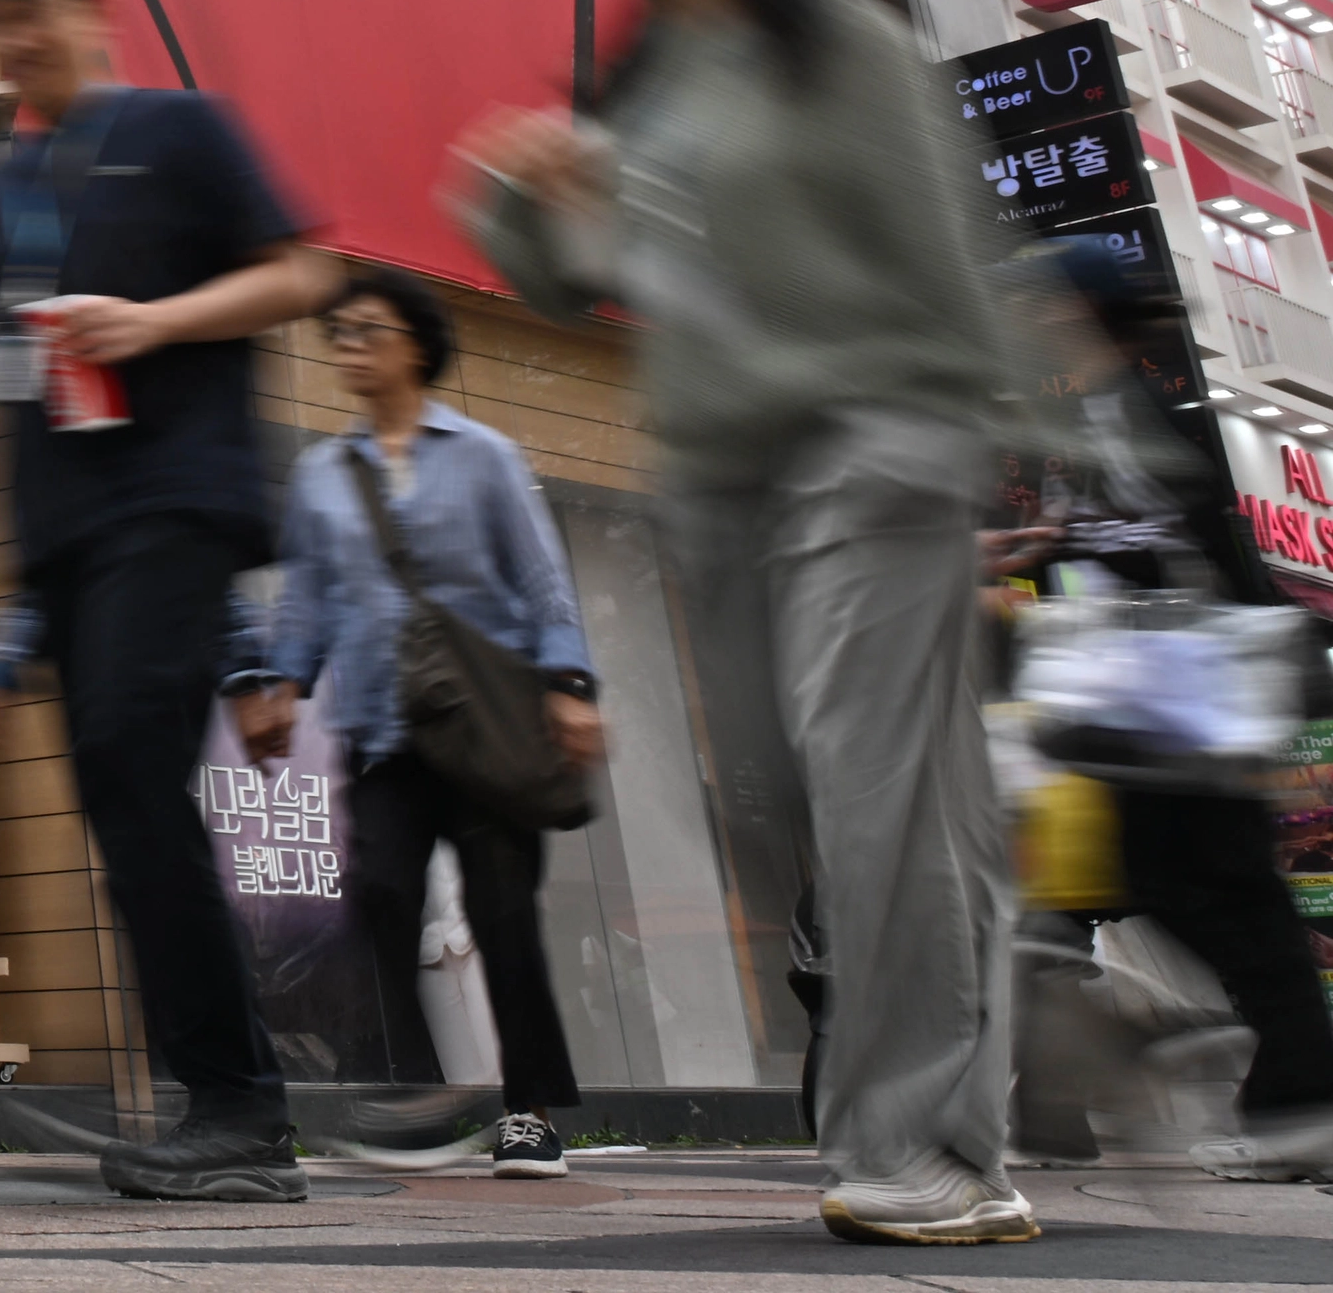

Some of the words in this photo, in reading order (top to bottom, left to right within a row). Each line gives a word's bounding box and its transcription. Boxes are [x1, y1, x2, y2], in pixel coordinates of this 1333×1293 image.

[955, 66, 1028, 96] Coffee
[1084, 86, 1106, 101] 9F
[962, 103, 979, 120] &
[982, 89, 1033, 114] Beer
[980, 135, 1110, 197] 방탈출
[1109, 180, 1131, 199] 8F
[996, 199, 1067, 223] Alcatraz
